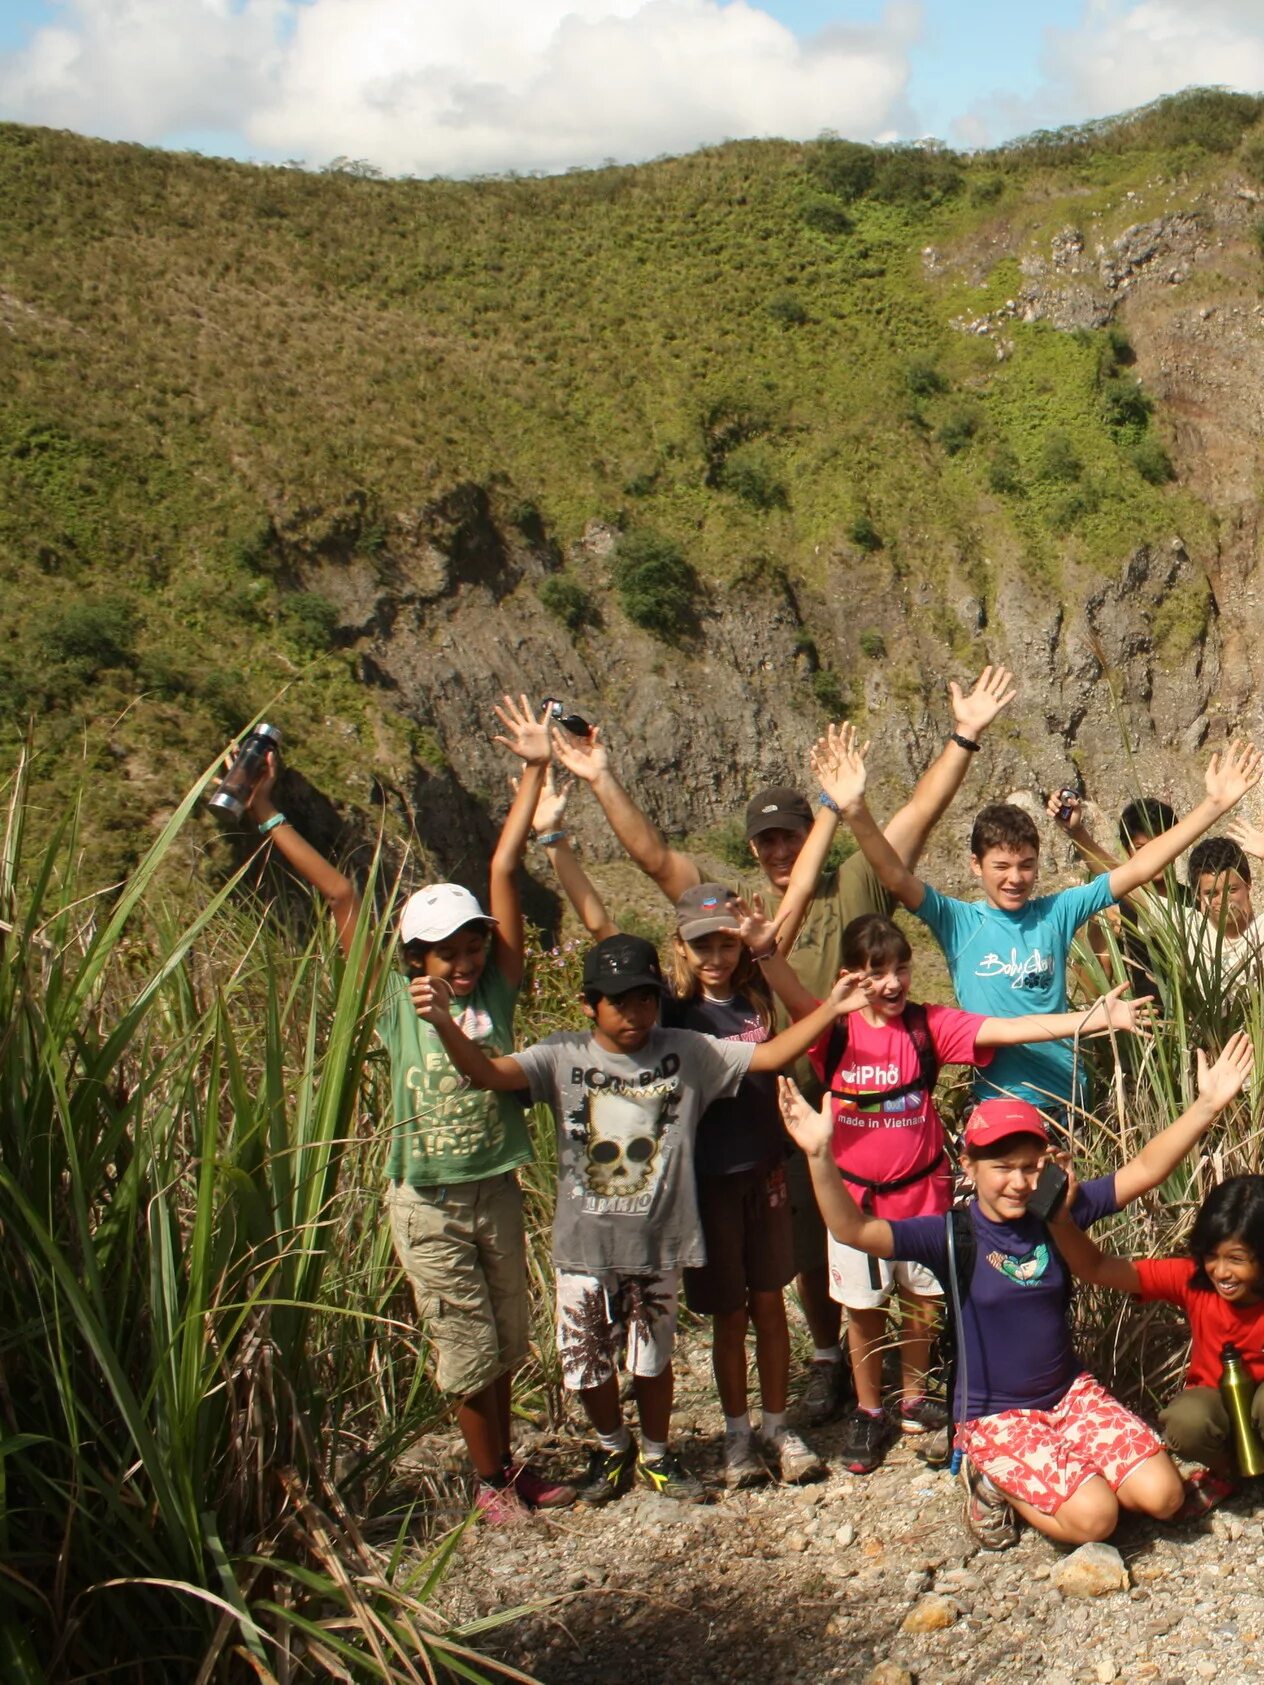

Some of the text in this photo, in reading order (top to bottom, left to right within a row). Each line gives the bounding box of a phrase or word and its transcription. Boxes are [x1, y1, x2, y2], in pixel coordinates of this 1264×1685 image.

[571, 1052, 681, 1092] BORN BAD
[838, 1114, 926, 1129] made in Vietnam
